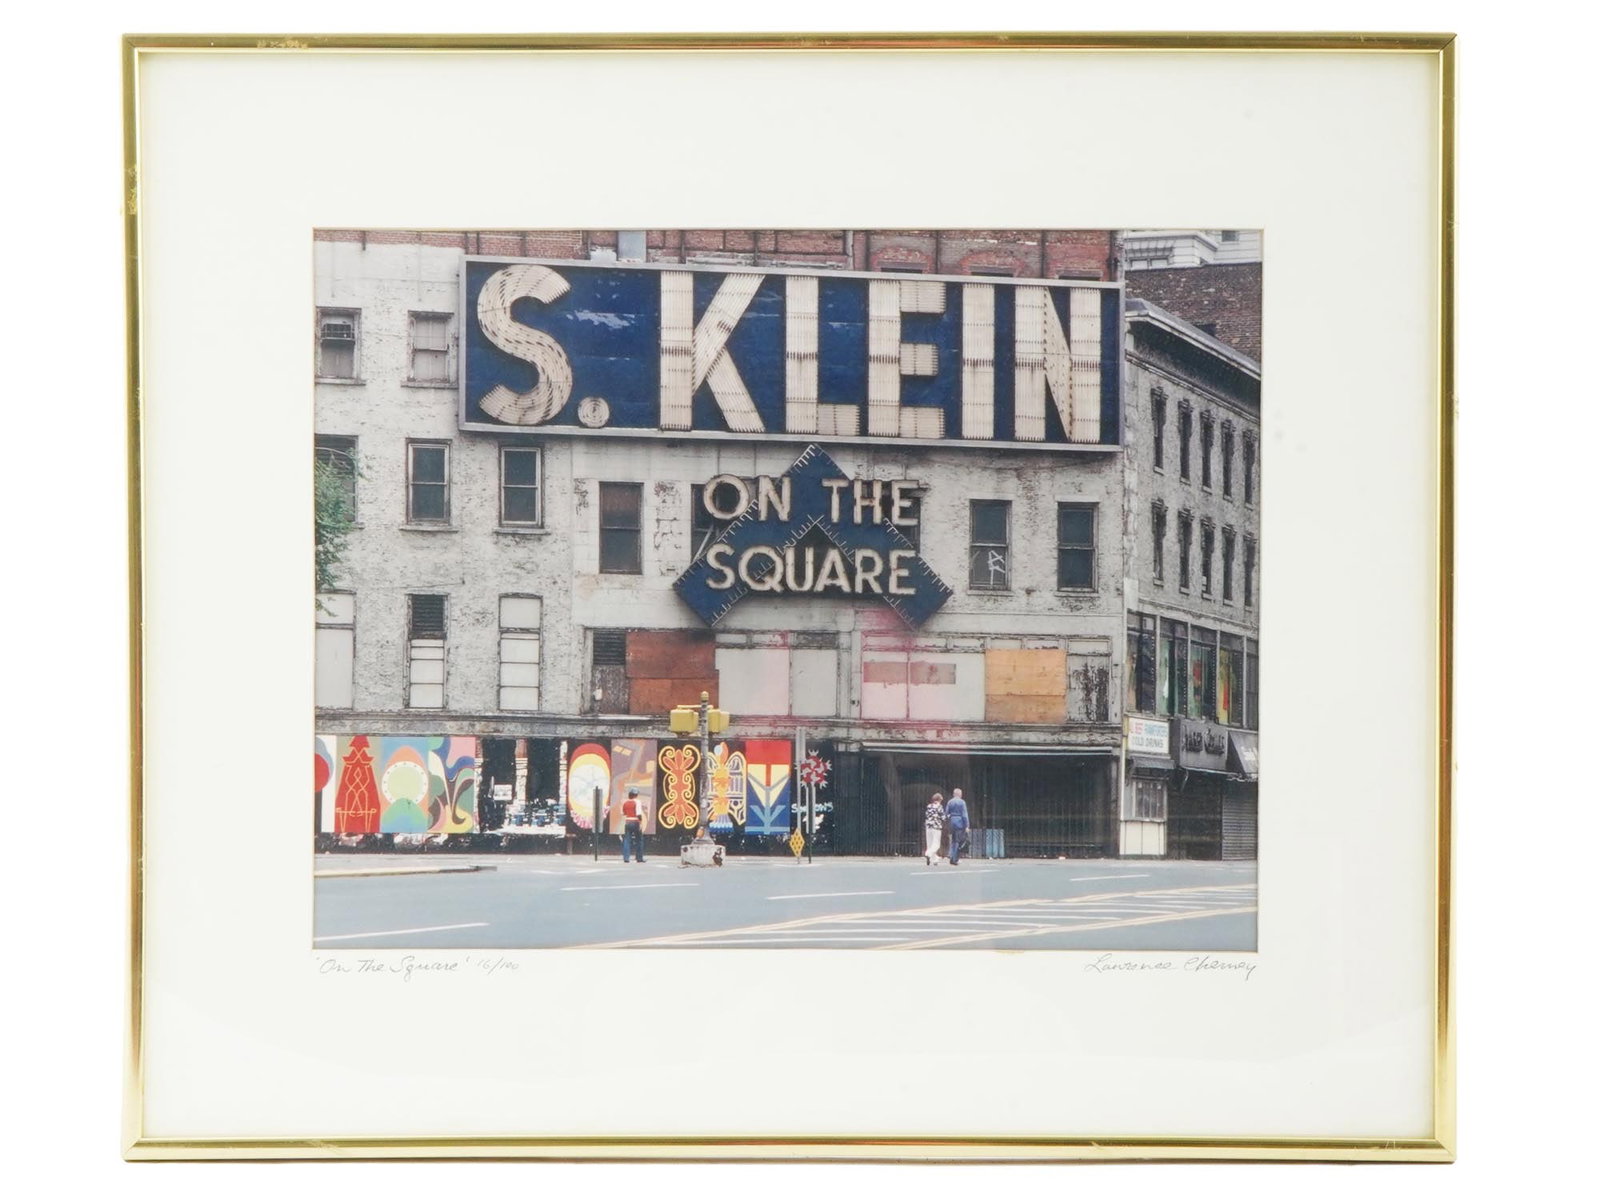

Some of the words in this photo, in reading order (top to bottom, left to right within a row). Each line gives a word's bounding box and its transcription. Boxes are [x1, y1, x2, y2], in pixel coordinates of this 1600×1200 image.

[477, 265, 609, 427] S.
[660, 270, 1101, 443] KLEIN
[703, 473, 790, 523] ON
[822, 477, 920, 526] THE
[705, 543, 916, 595] SQUARE
[358, 959, 384, 973] The
